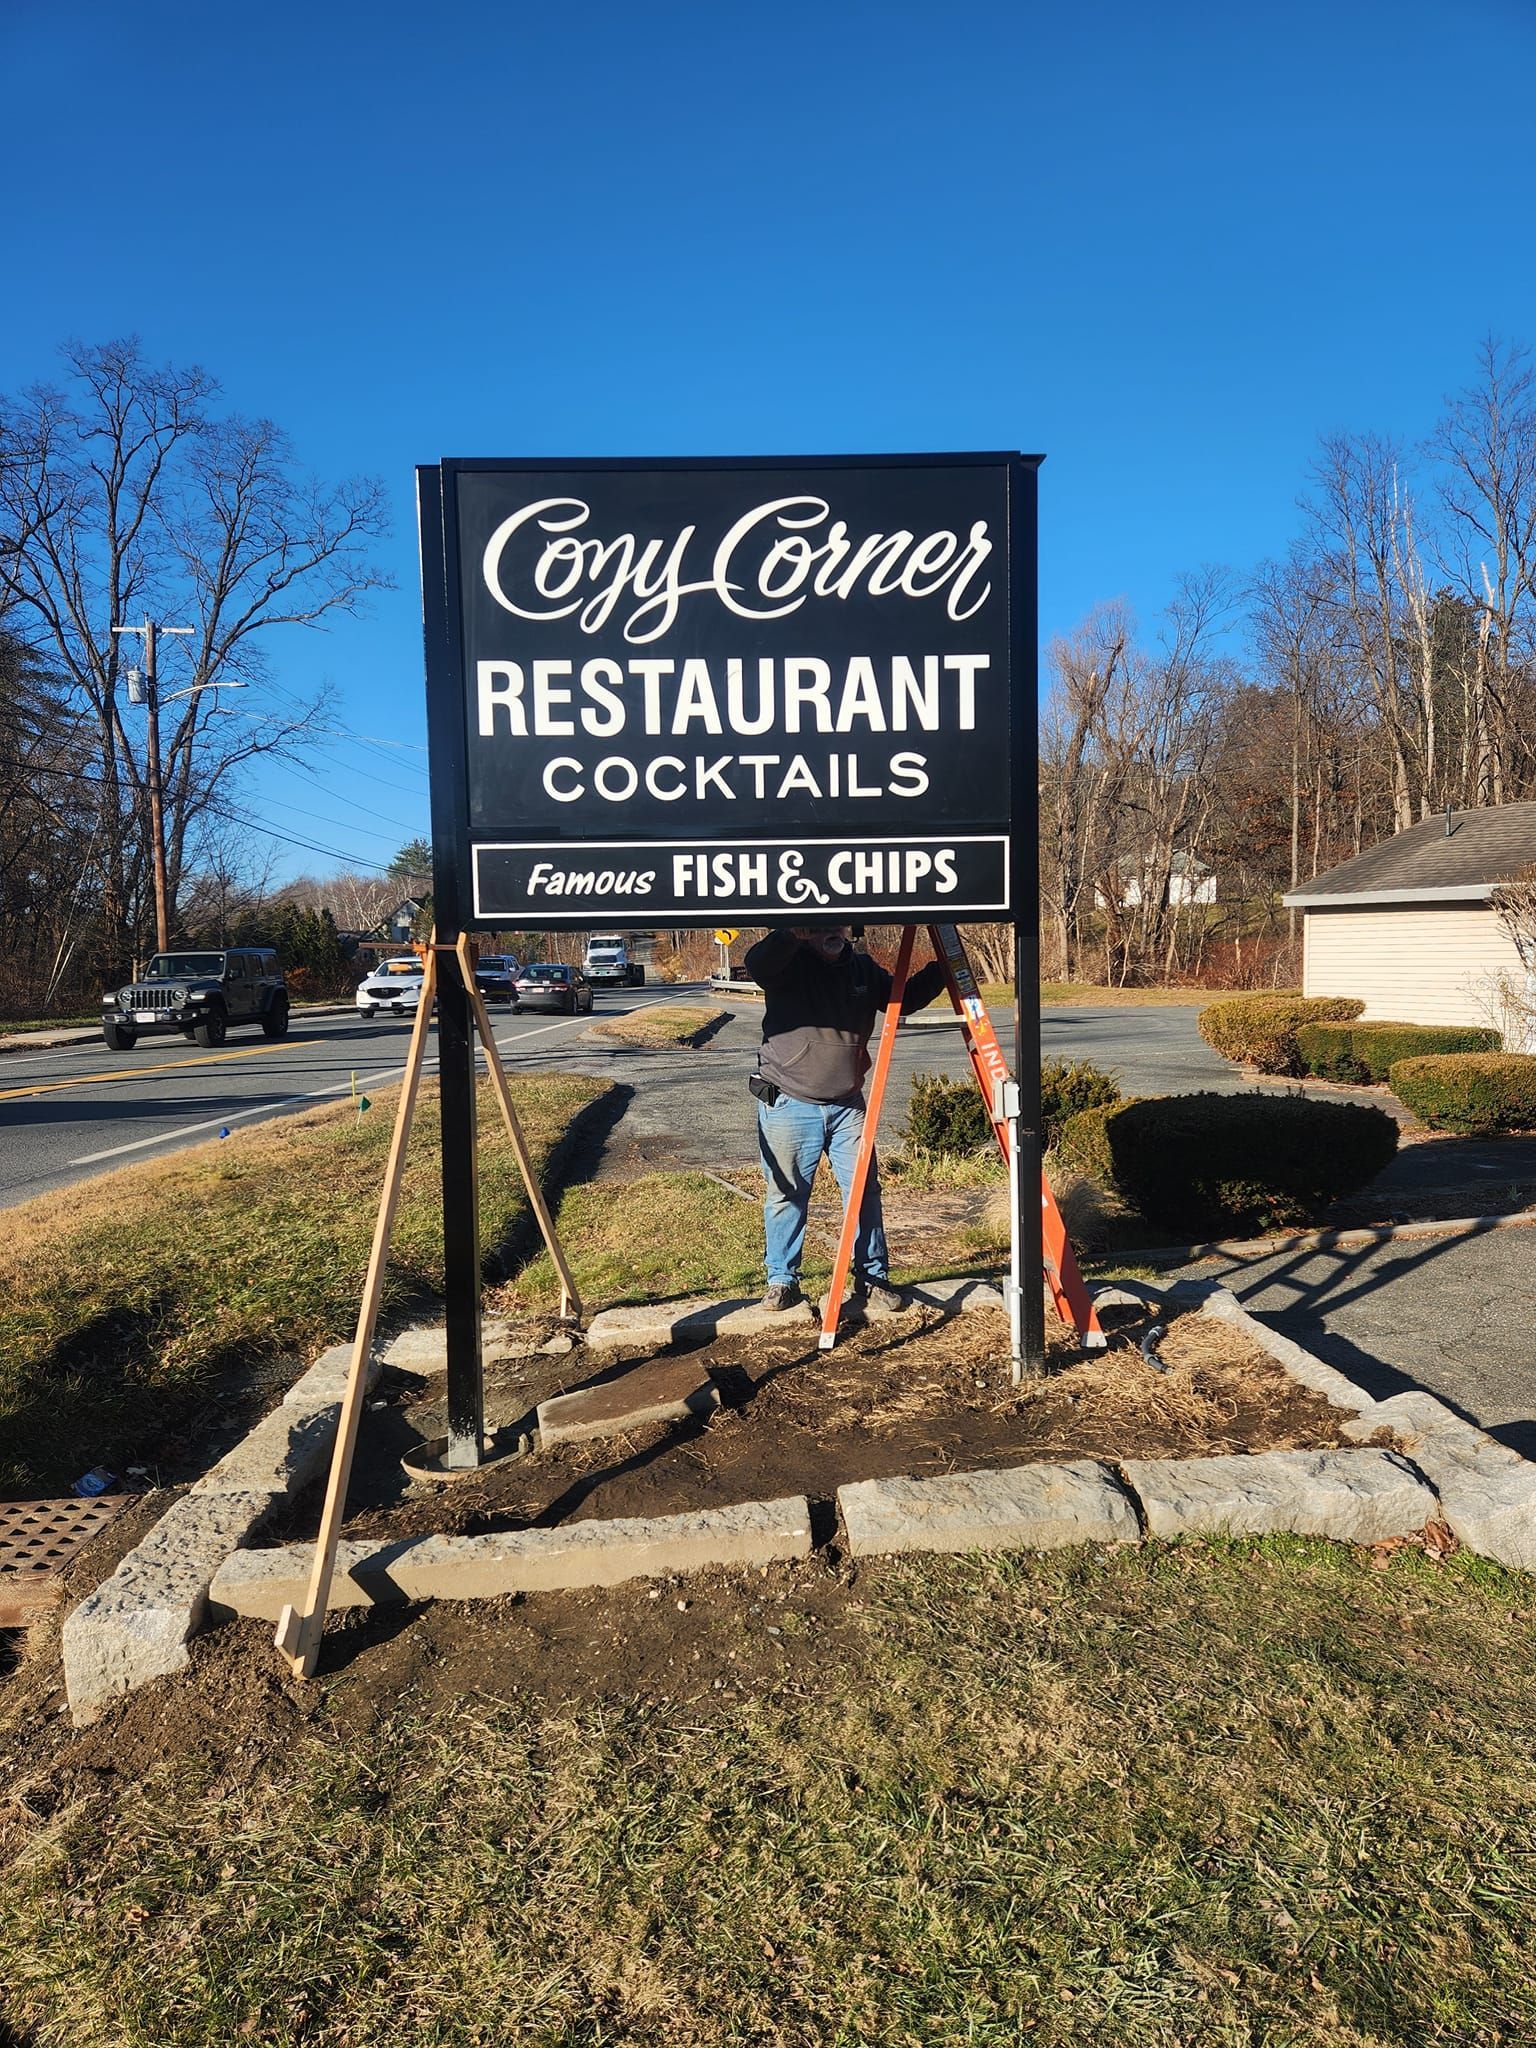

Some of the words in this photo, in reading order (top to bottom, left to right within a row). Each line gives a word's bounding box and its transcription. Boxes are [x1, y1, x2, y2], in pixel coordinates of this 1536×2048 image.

[483, 498, 712, 644] Cozy
[714, 496, 992, 621] Corner
[477, 655, 989, 738] RESTAURANT
[543, 752, 929, 802] COCKTAILS
[527, 863, 655, 896] Famous
[673, 852, 767, 897] FISH
[777, 850, 829, 904] &
[828, 849, 957, 896] CHIPS
